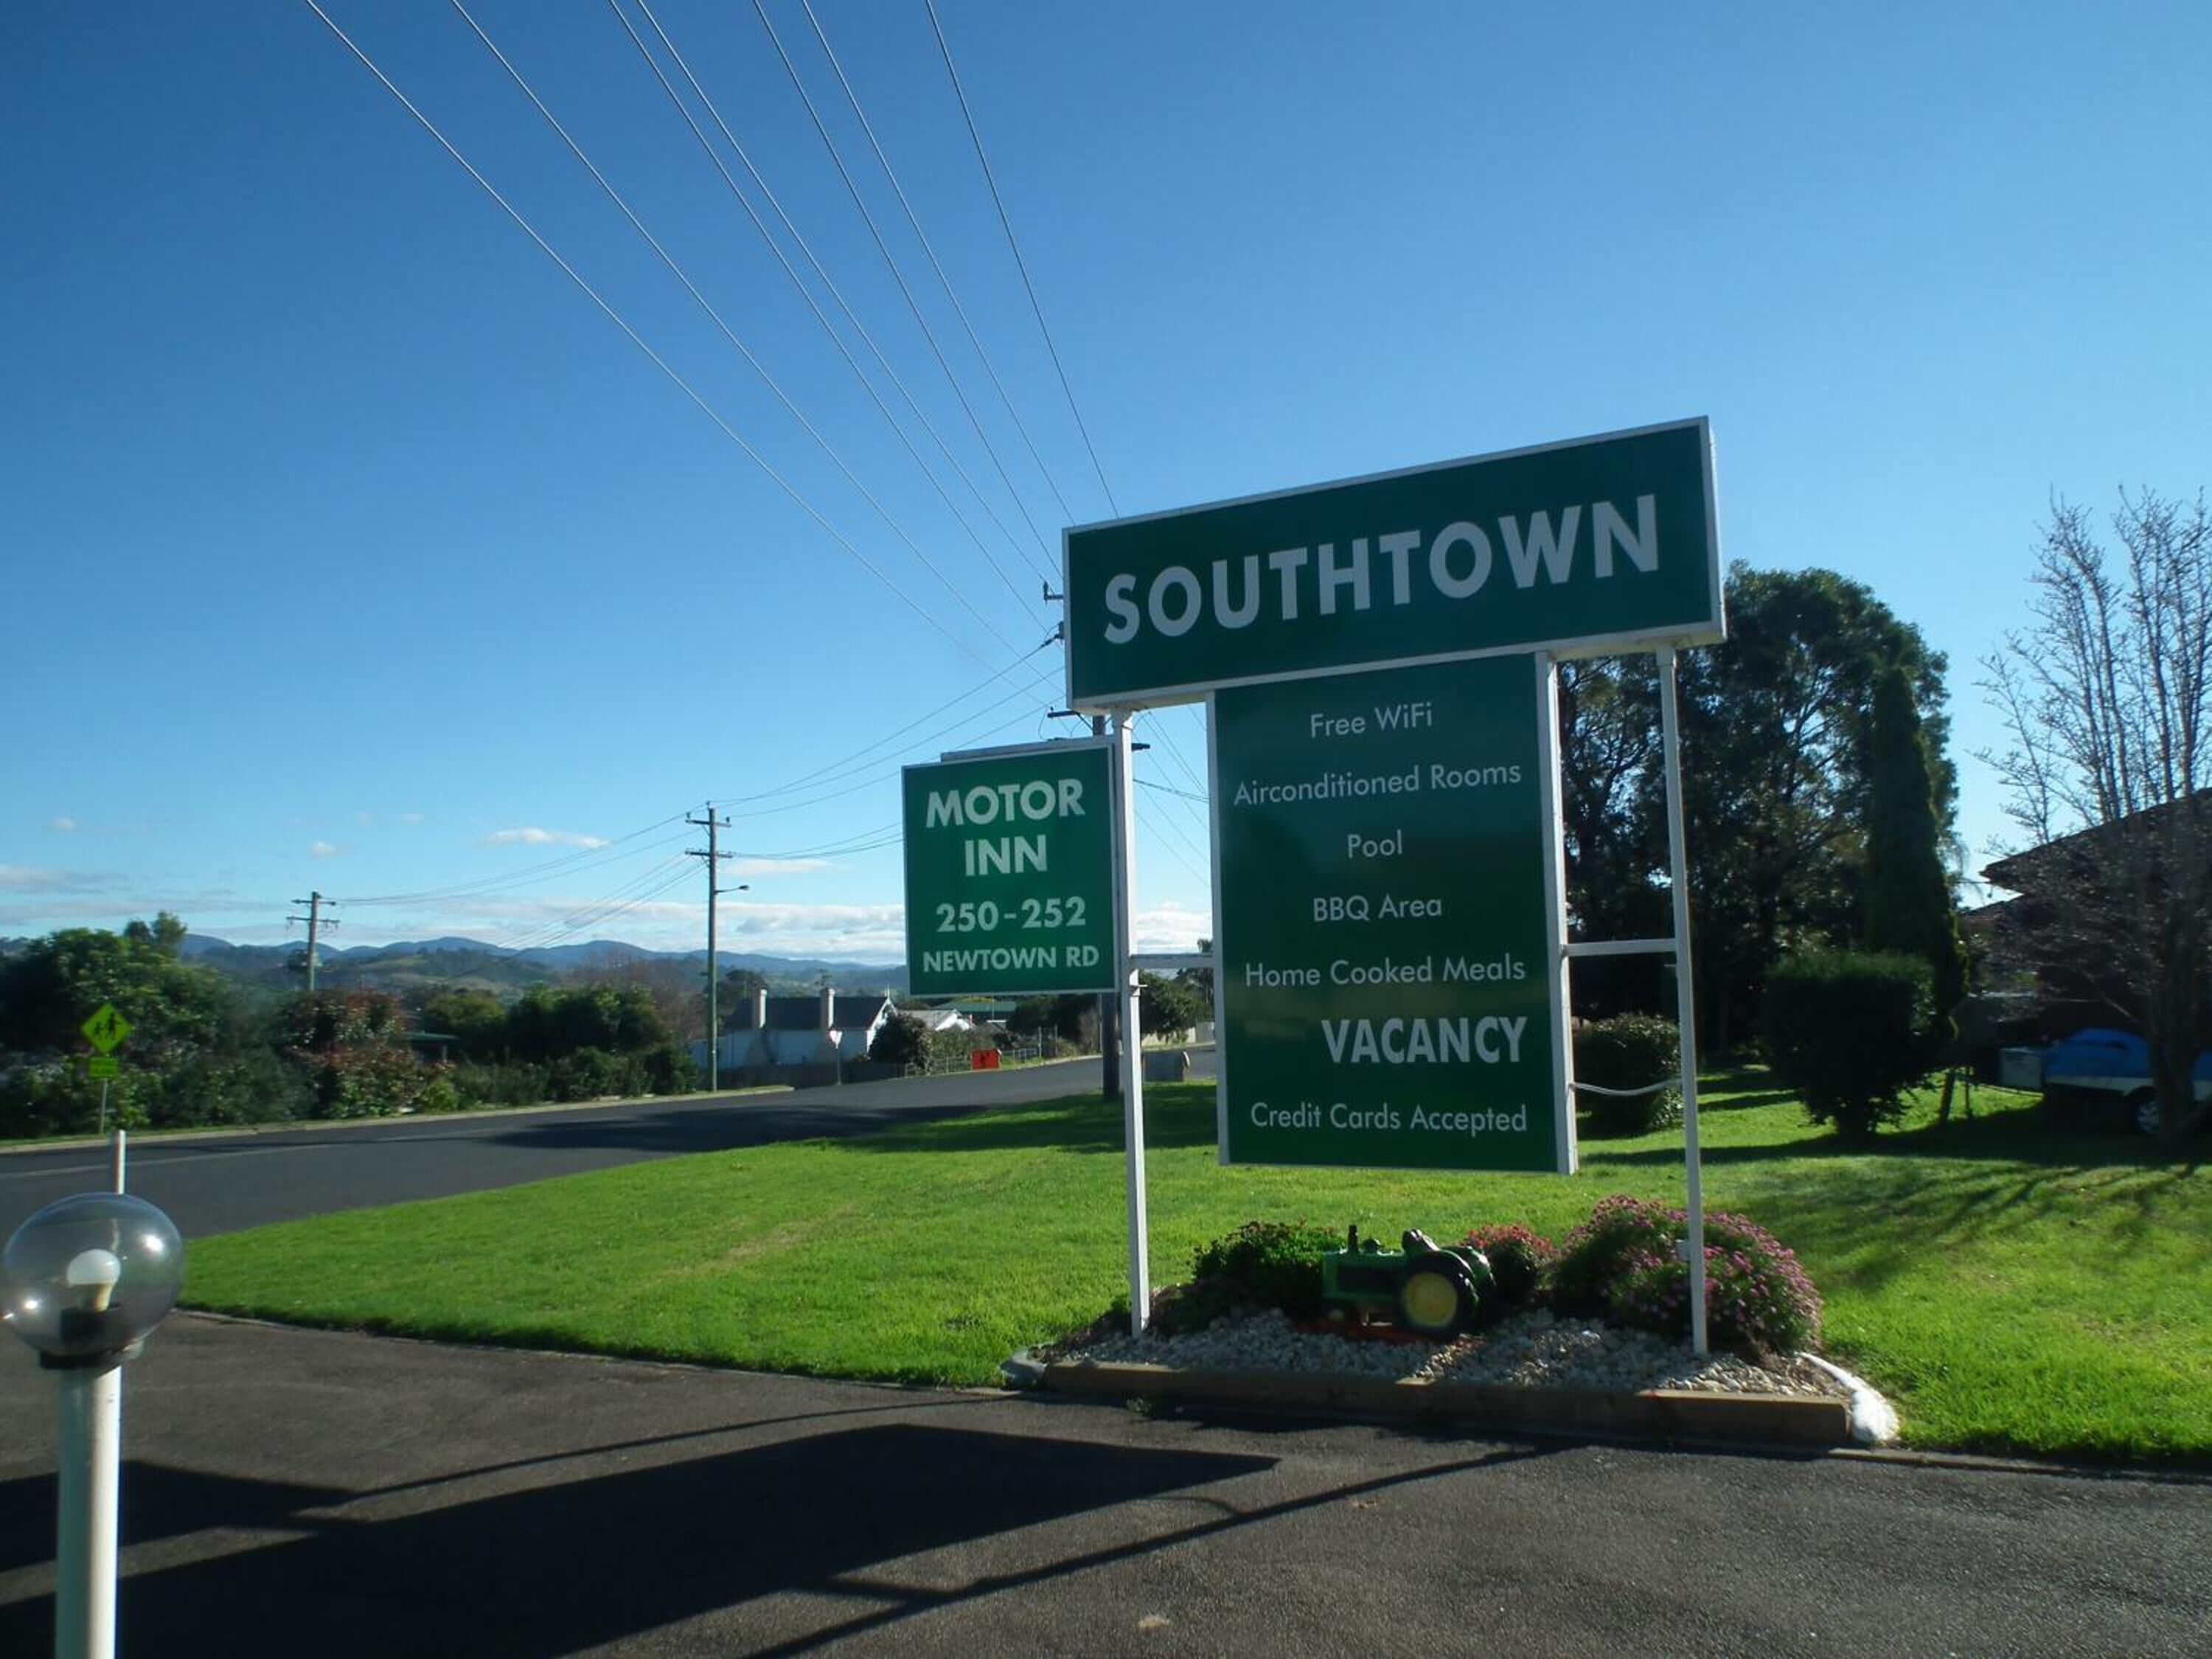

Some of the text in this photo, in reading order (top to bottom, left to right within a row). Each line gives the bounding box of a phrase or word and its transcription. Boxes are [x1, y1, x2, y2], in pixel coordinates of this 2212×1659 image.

[1105, 495, 1660, 644] SOUTHTOWN
[1310, 703, 1433, 739] Free WiFi
[925, 778, 1086, 829] MOTOR
[1234, 764, 1522, 806] Airconditioned Rooms
[964, 834, 1047, 876] INN
[1347, 829, 1403, 859] Pool
[936, 896, 1086, 933] 250-252
[1313, 894, 1443, 922] BBQ Area
[923, 945, 1099, 973] NEWTOWN RD
[1245, 953, 1526, 988] Home Cooked Meals
[1321, 1015, 1528, 1064] VACANCY
[1251, 1101, 1527, 1138] Credit Cards Accepted
